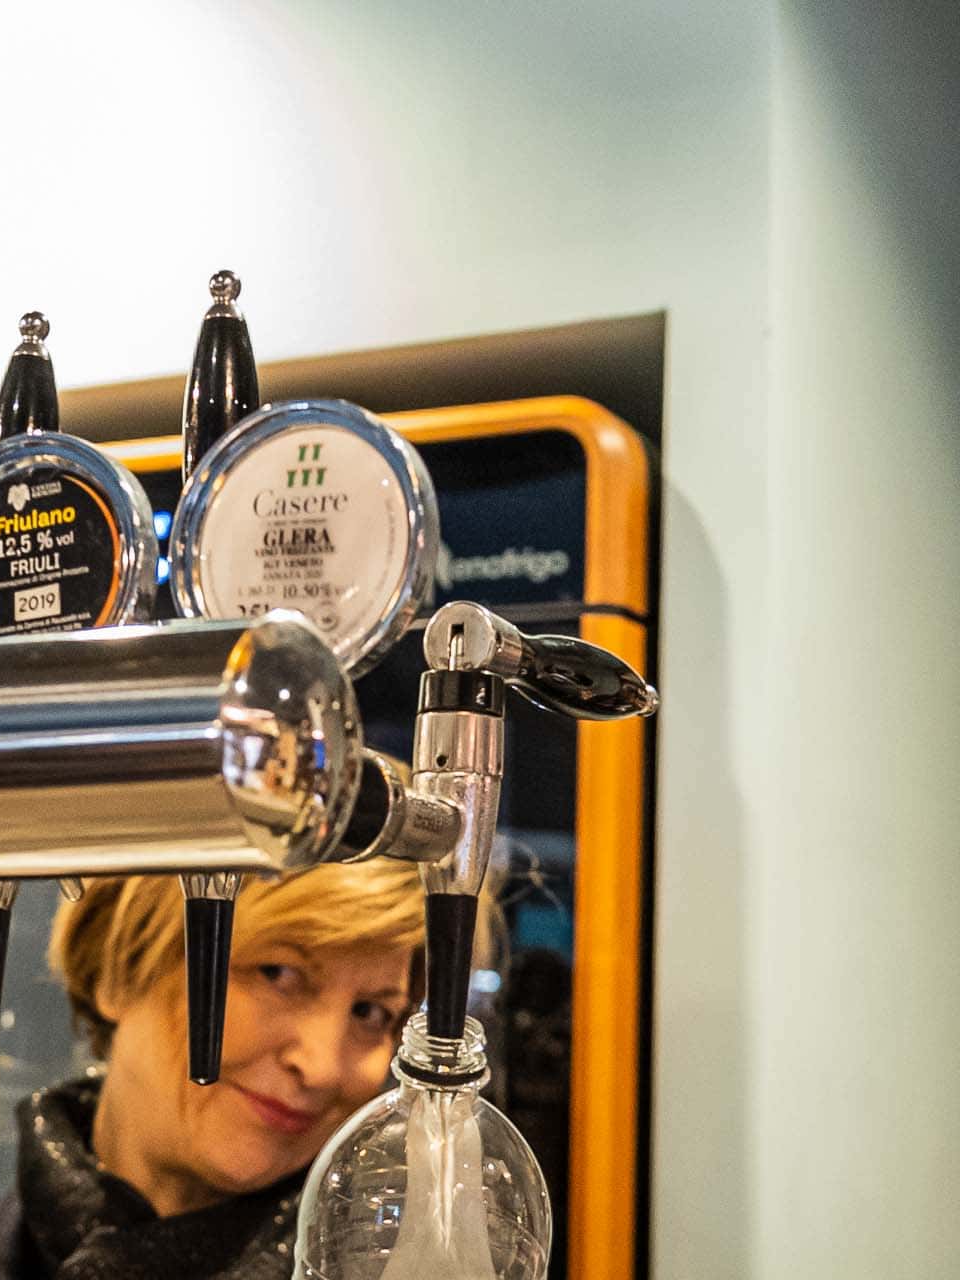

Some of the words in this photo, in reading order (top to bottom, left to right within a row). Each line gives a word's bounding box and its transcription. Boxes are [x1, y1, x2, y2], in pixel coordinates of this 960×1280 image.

[253, 489, 348, 519] Casere
[37, 529, 54, 550] %
[56, 531, 74, 546] vol
[263, 527, 333, 546] GLERA
[10, 552, 60, 577] FRIULI
[18, 592, 57, 613] 2019
